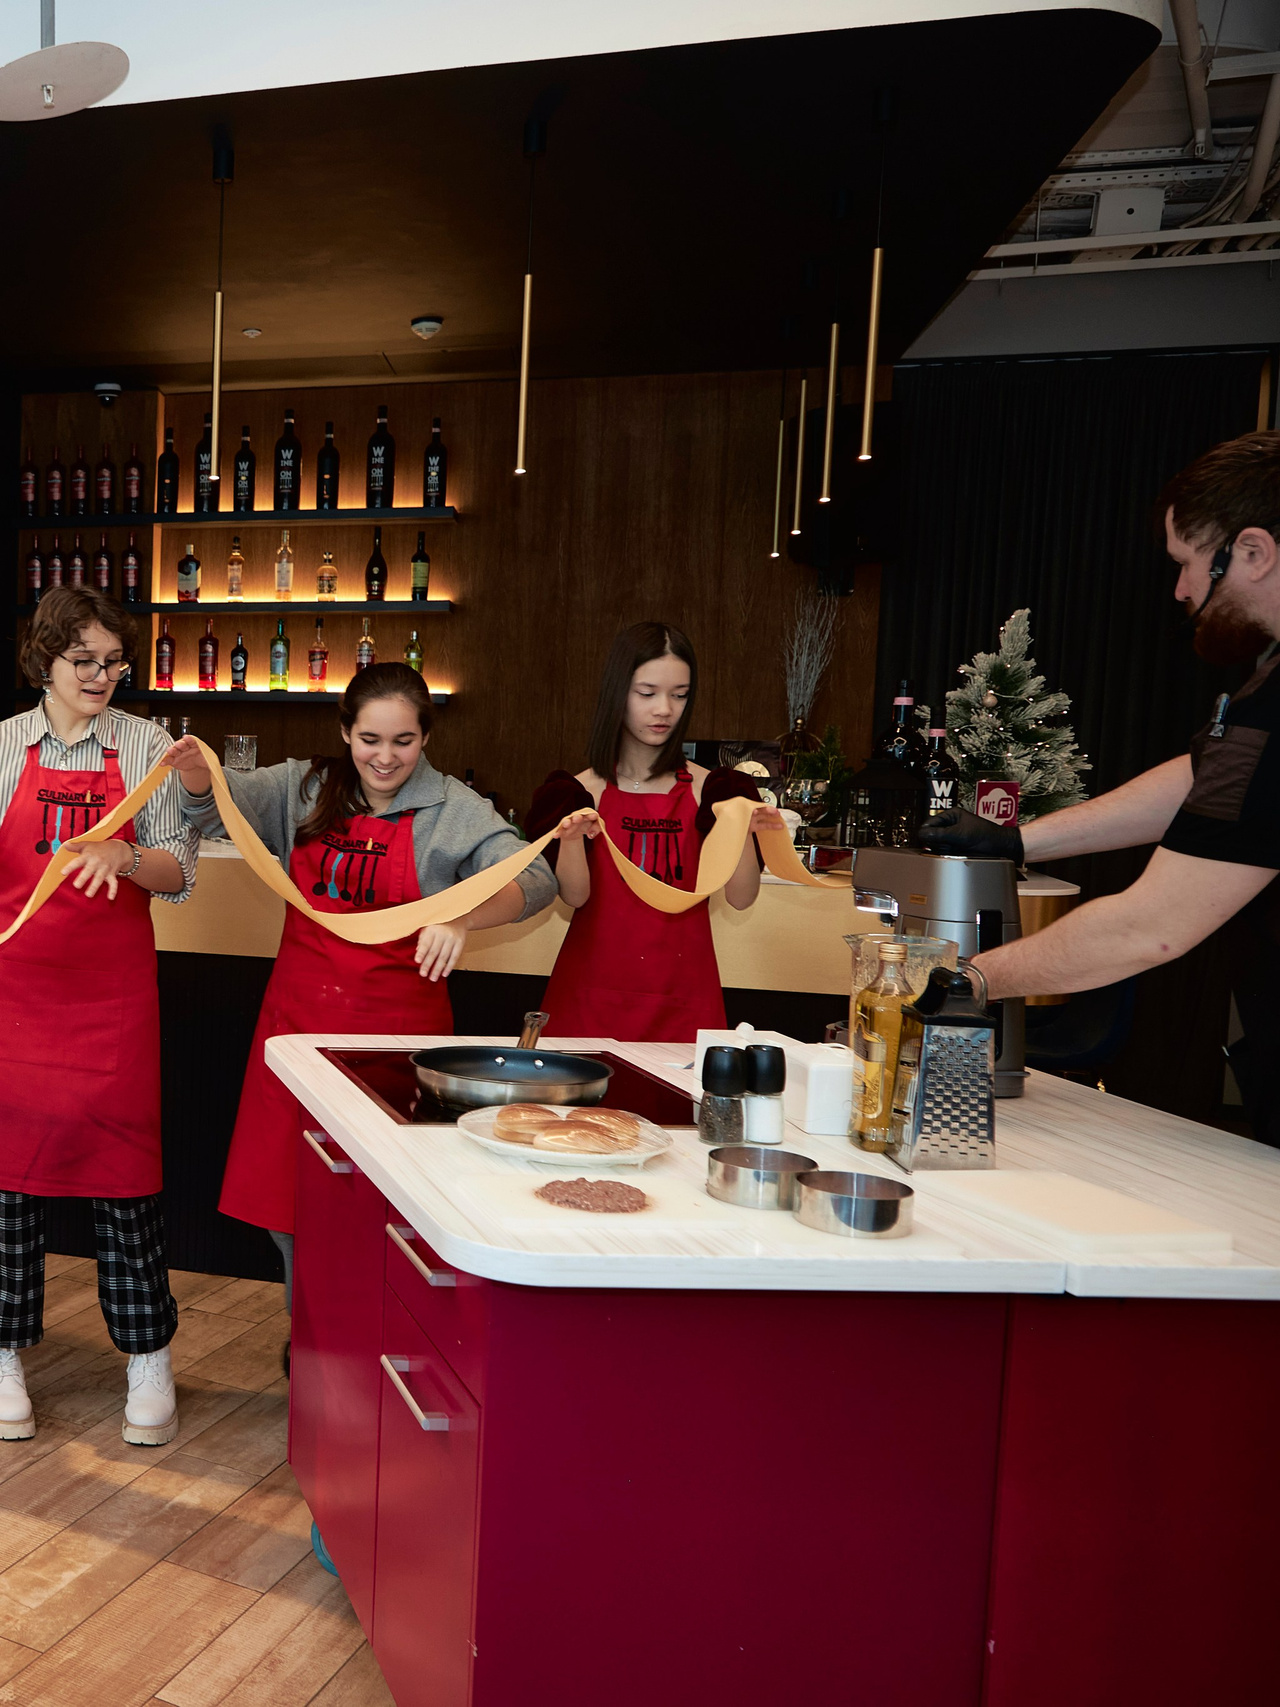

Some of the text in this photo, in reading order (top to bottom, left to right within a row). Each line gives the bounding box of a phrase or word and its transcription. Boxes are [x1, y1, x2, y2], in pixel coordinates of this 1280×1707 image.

[281, 449, 294, 460] W
[372, 446, 385, 457] W
[239, 461, 249, 471] W
[428, 456, 440, 466] W
[931, 780, 954, 797] W
[38, 789, 106, 802] CULINARY ON
[929, 797, 953, 809] INE
